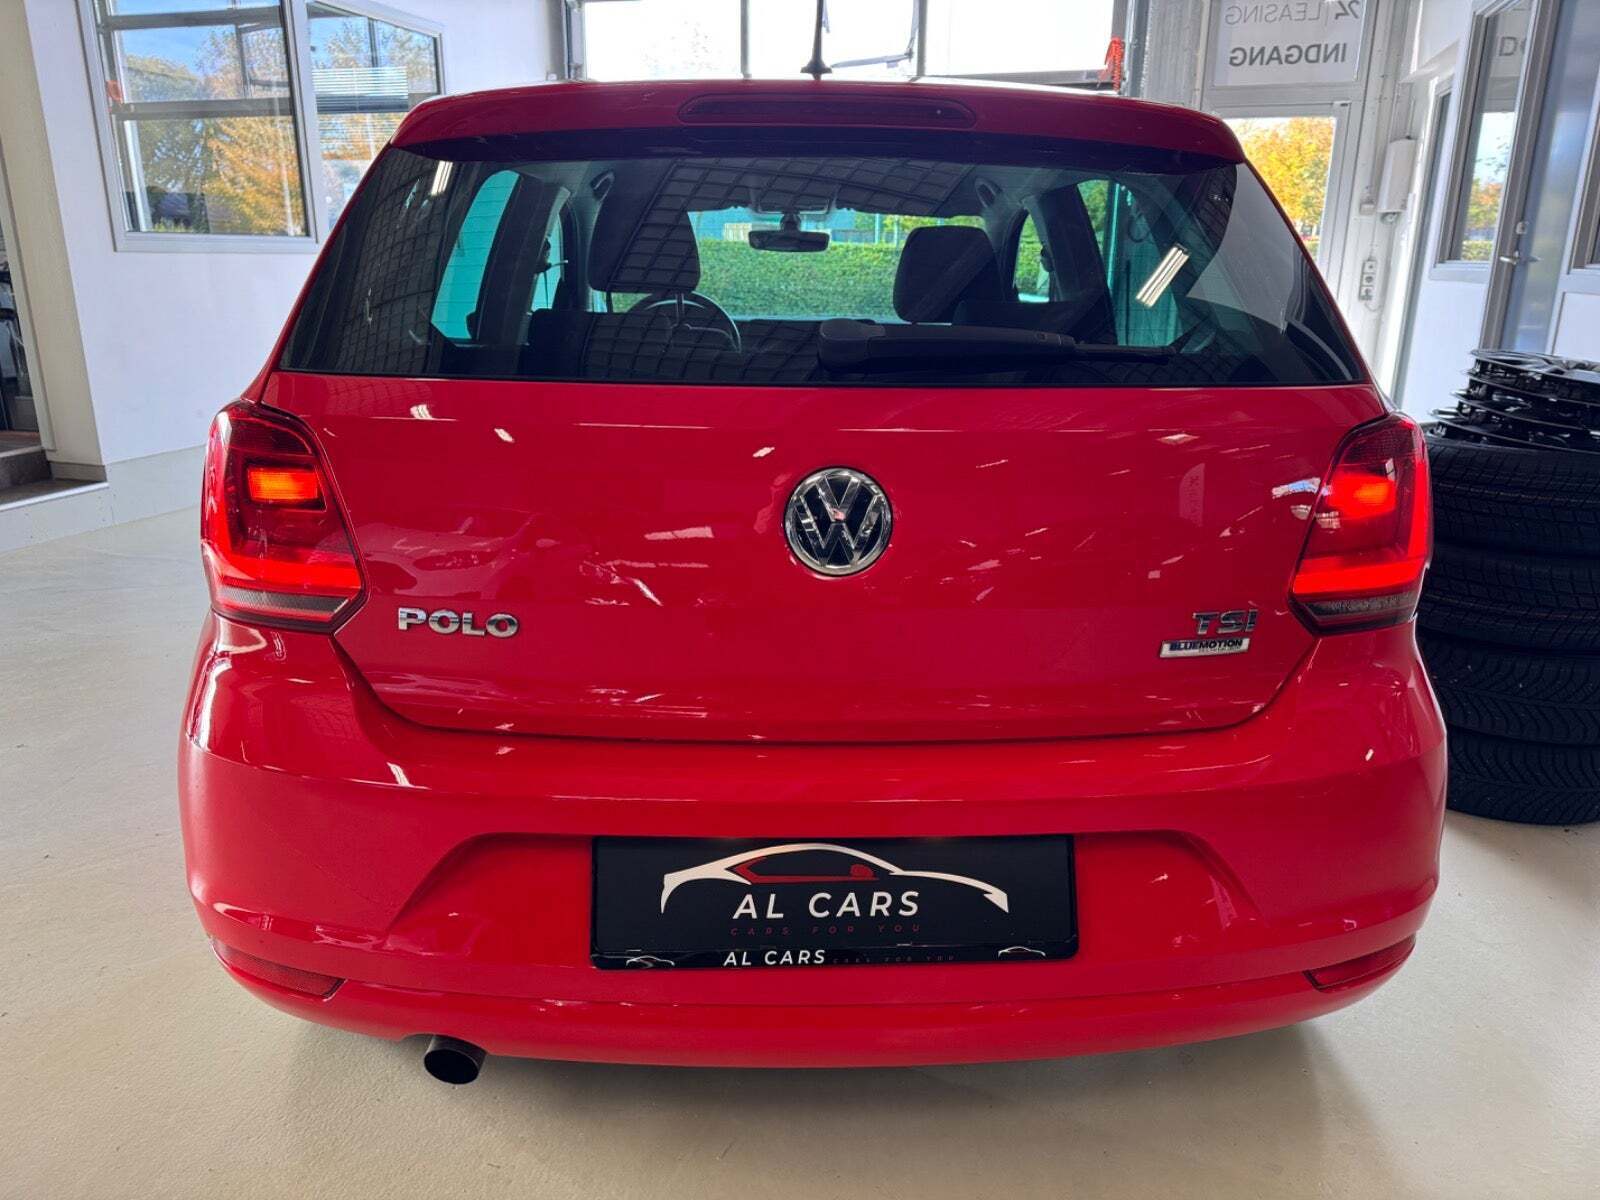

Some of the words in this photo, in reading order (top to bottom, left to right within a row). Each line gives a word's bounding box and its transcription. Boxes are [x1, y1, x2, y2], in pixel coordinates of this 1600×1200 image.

[398, 607, 519, 638] POLO
[1192, 609, 1258, 635] TSI
[1169, 638, 1243, 652] BLUEMOTION
[732, 893, 784, 920] AL
[808, 890, 920, 918] CARS
[730, 926, 790, 936] CARS
[811, 924, 855, 935] FOR
[878, 923, 920, 933] YOU
[723, 951, 752, 966] AL
[764, 949, 826, 965] CARS
